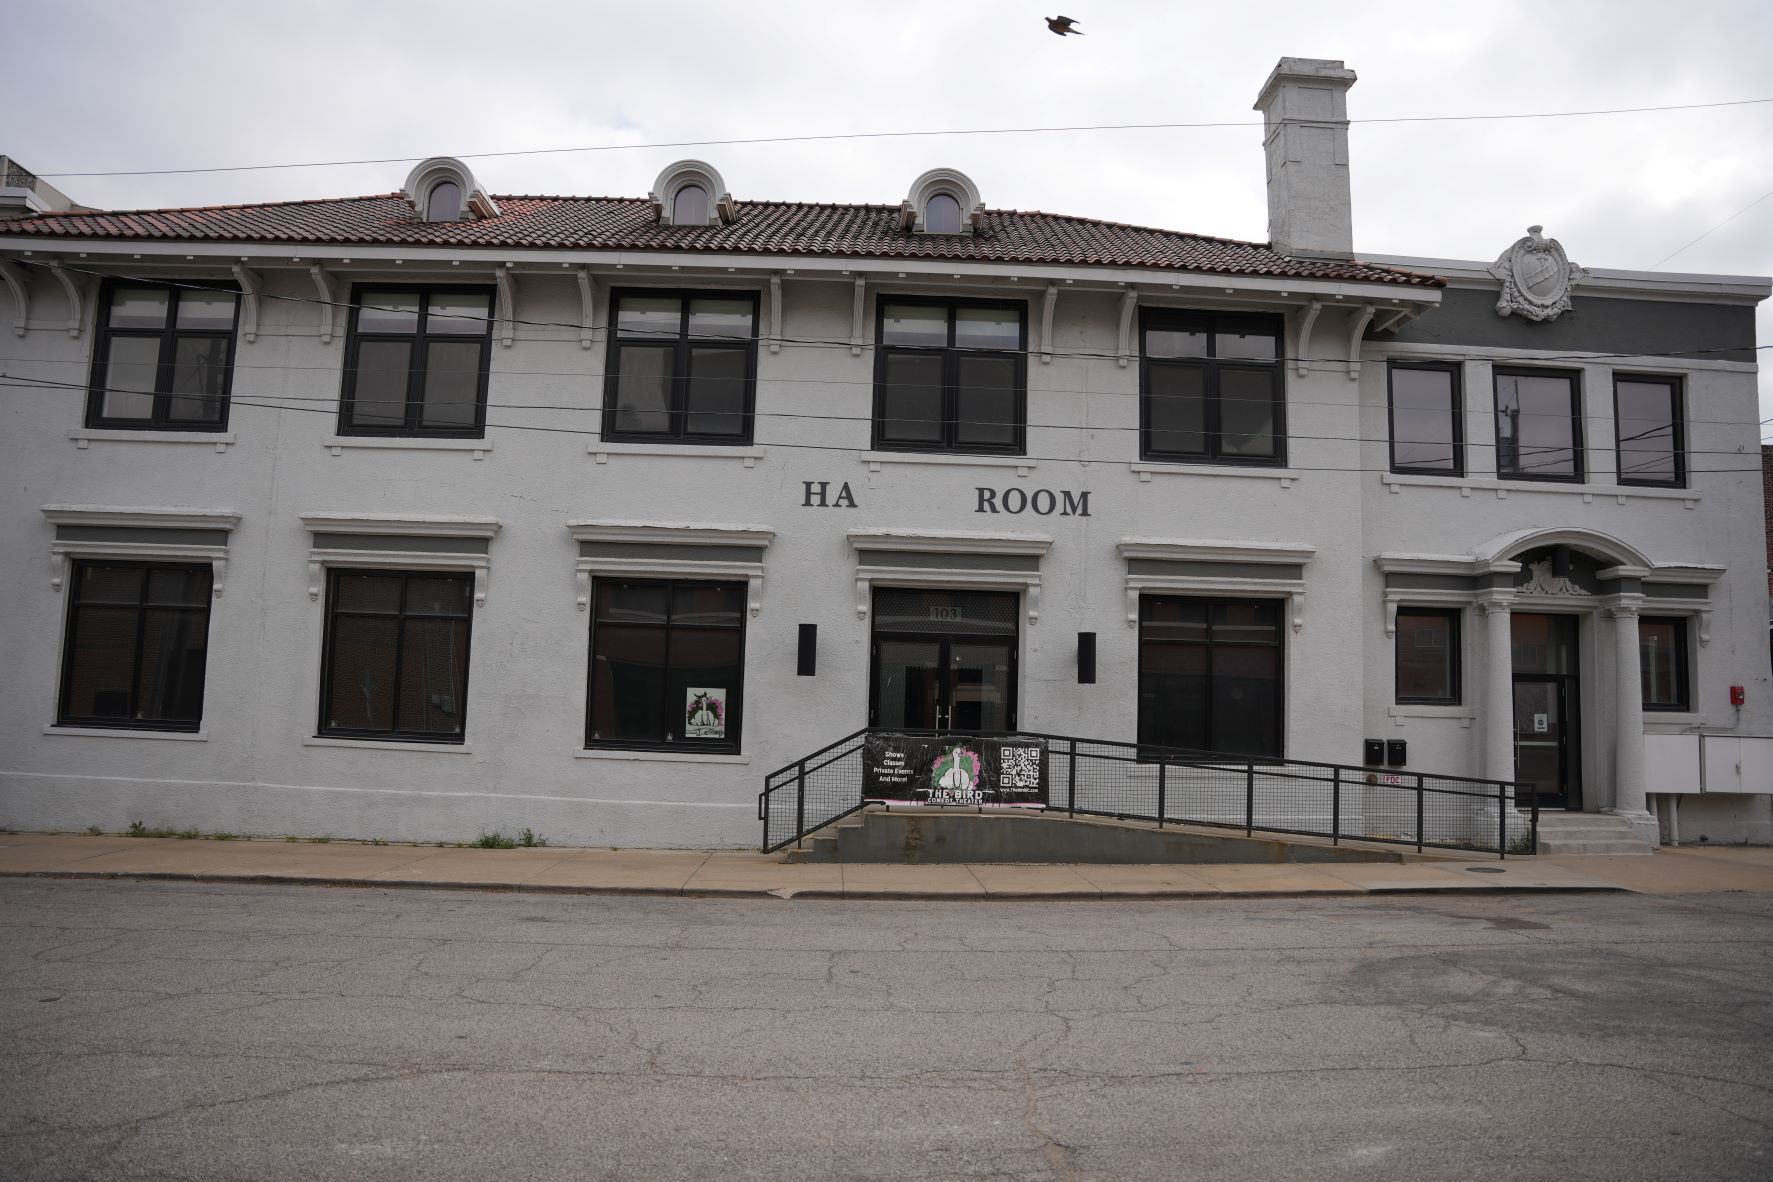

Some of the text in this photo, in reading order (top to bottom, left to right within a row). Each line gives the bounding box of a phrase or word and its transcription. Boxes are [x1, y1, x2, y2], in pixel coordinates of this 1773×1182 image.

[801, 481, 1092, 517] HA ROOM
[934, 607, 957, 620] 103
[1385, 776, 1401, 785] FDC
[928, 789, 983, 800] THE BIRD
